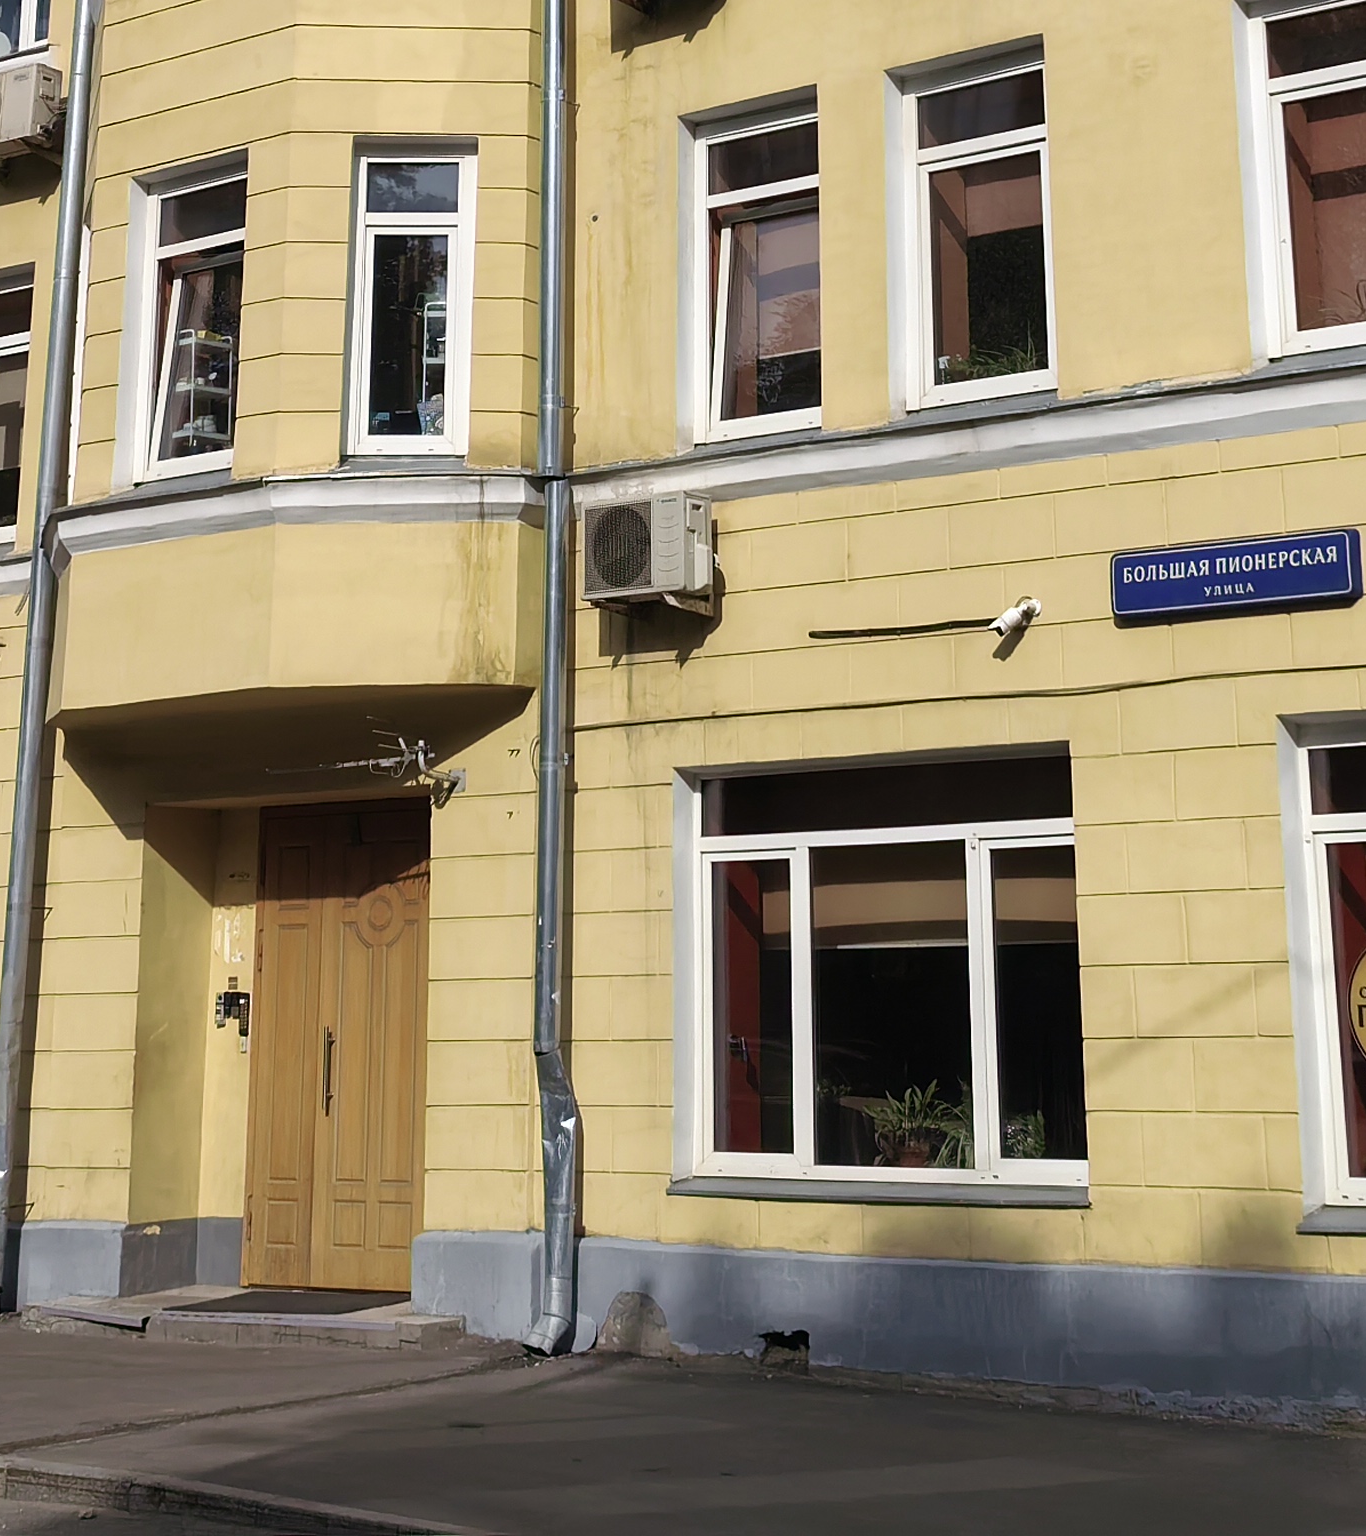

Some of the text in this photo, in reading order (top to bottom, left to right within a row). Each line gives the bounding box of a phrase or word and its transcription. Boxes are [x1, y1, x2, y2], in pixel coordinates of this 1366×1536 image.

[1123, 545, 1338, 584] БОЛЬШАЯ ПИОНЕРСКАЯ
[1203, 582, 1255, 598] УЛИЦА
